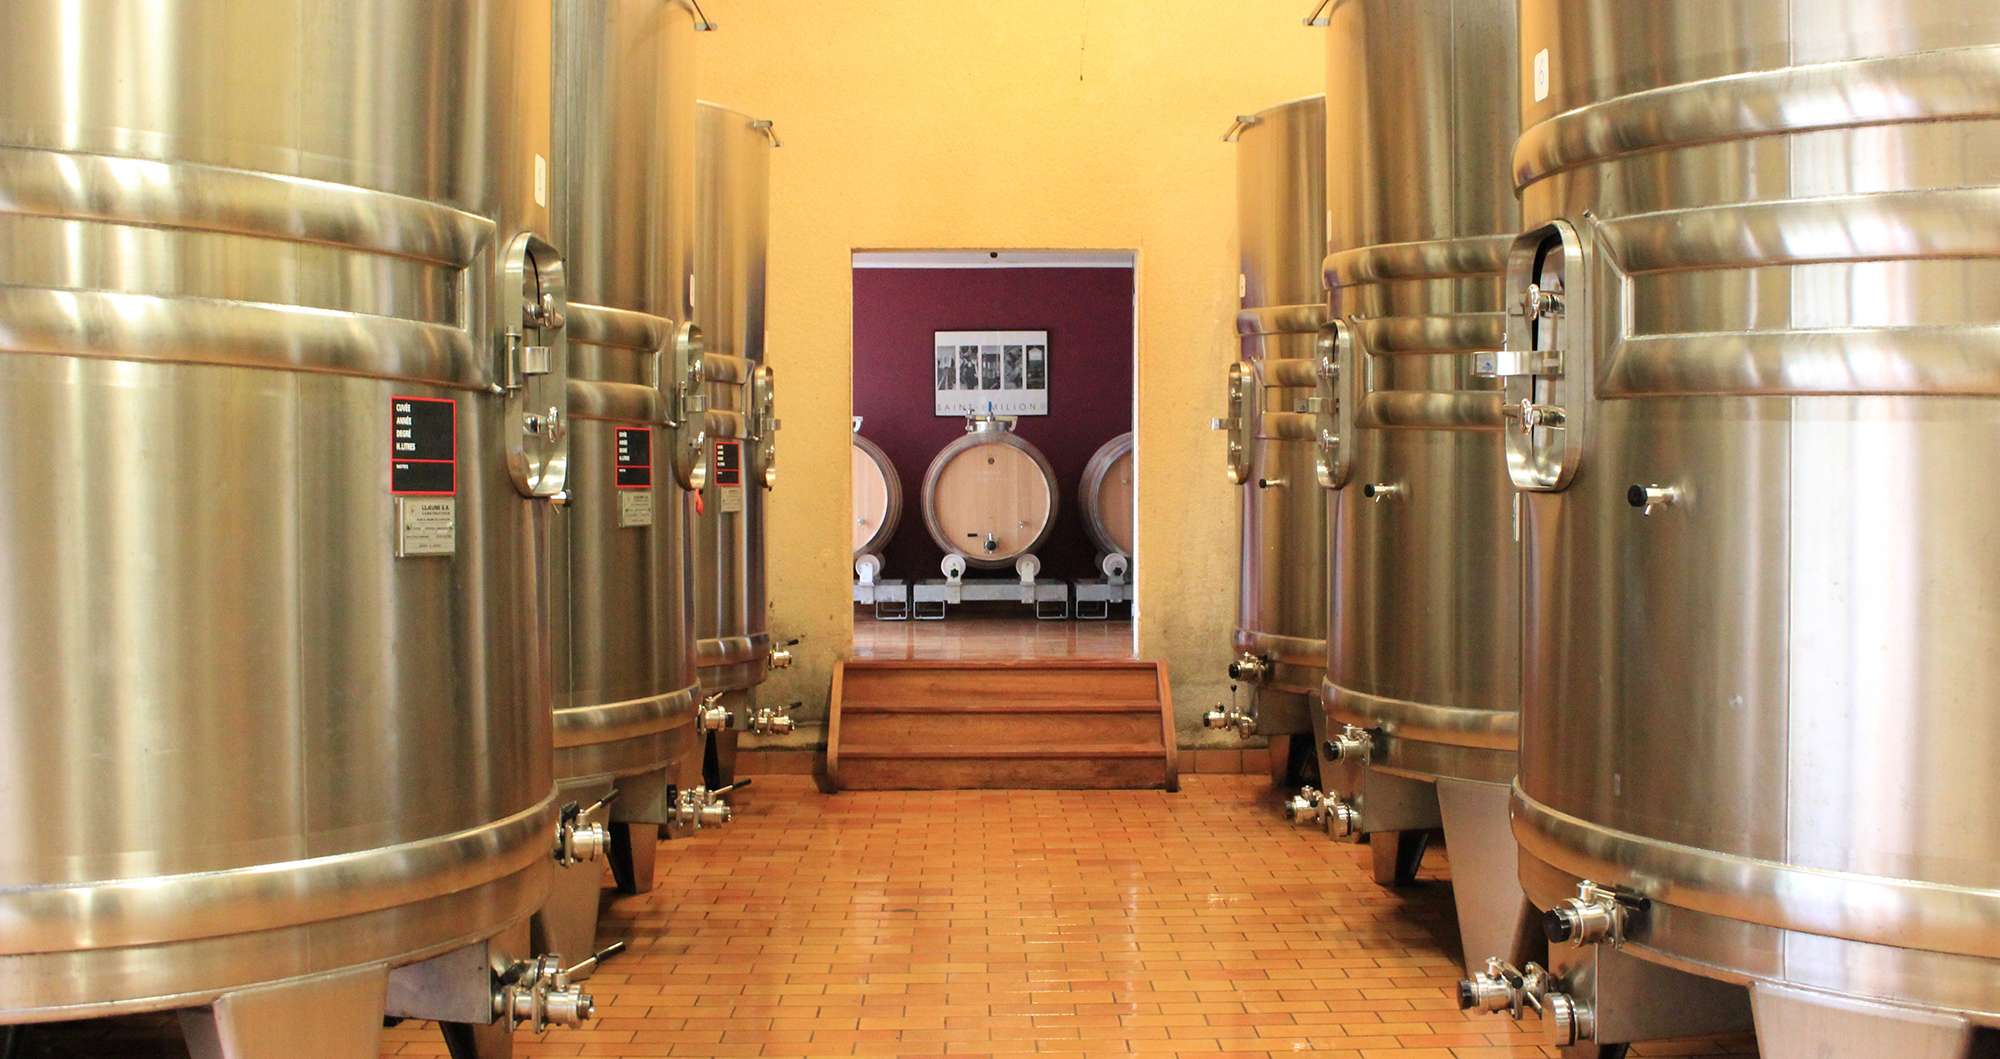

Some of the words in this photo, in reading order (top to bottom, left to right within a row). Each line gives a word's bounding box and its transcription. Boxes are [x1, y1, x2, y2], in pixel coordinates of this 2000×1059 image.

[396, 403, 411, 412] CUVÉE
[396, 416, 412, 425] ANNÉE
[396, 429, 411, 438] DEGRÉ
